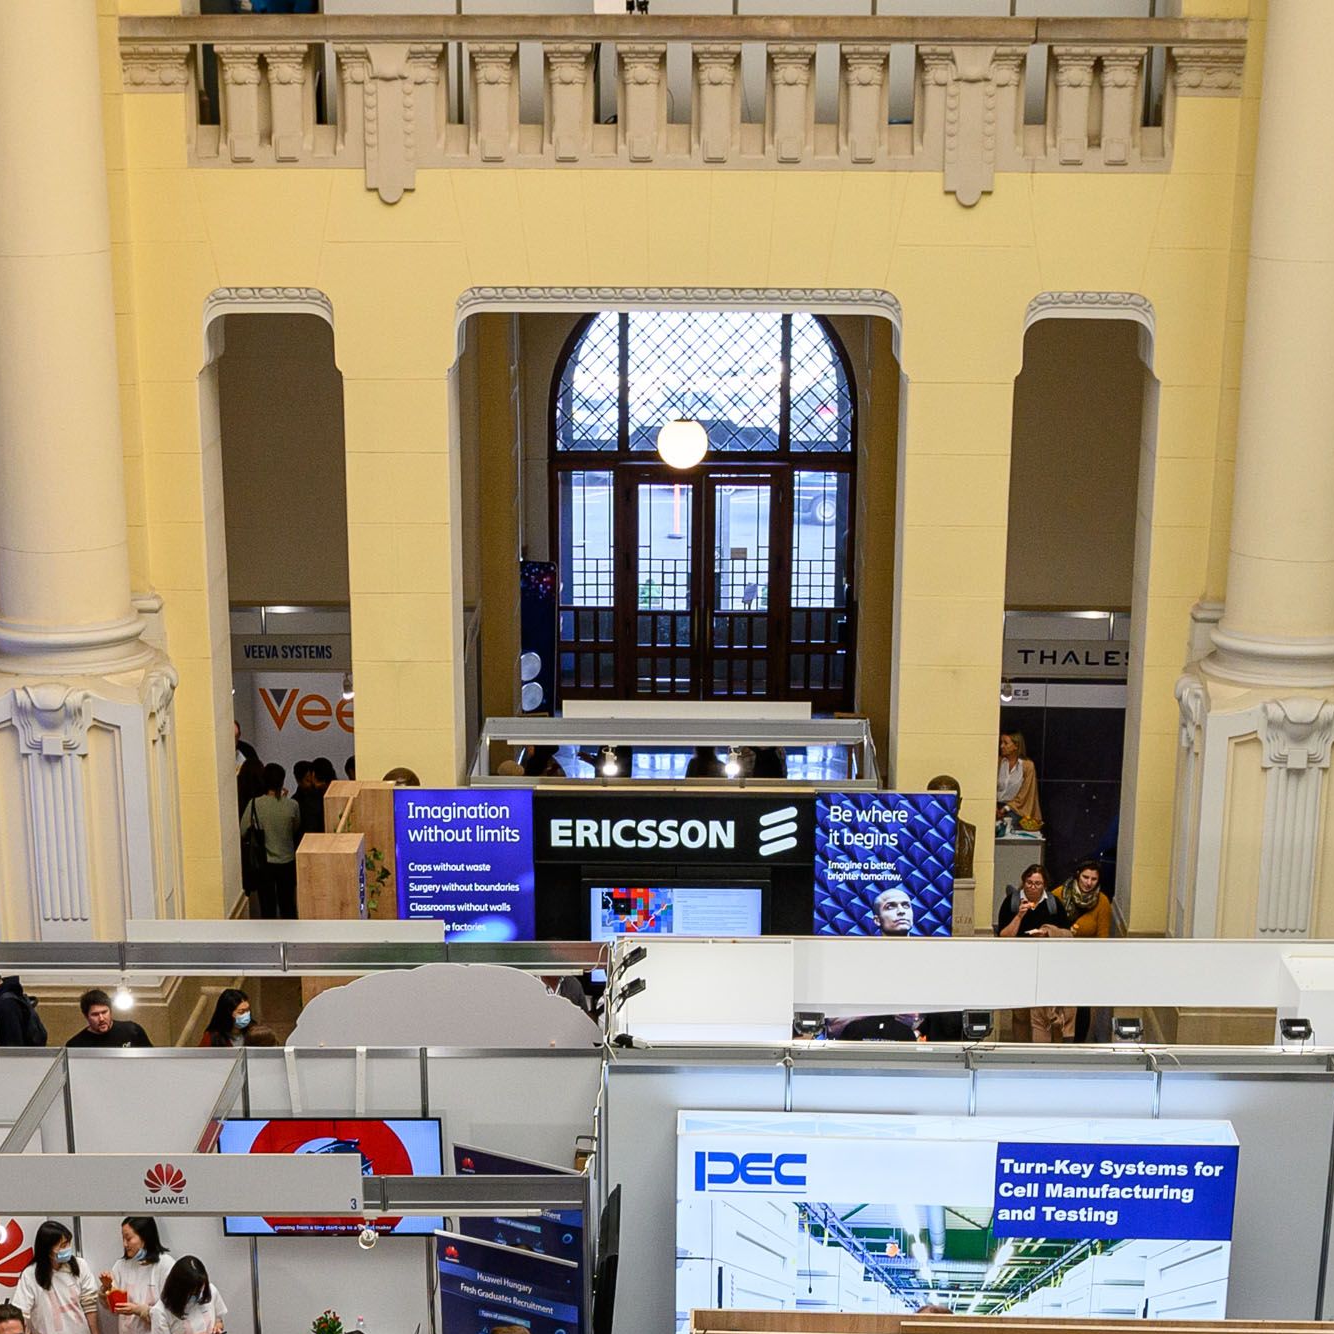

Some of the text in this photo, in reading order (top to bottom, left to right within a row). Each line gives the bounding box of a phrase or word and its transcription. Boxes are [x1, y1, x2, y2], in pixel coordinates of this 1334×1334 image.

[244, 645, 333, 659] VEEVA SYSTEMS
[1017, 649, 1129, 666] THALE
[407, 802, 509, 822] Imagination
[829, 805, 908, 823] Be where
[407, 825, 520, 842] without limits
[550, 819, 735, 849] ERICSSON
[828, 829, 899, 849] it begins
[408, 862, 492, 873] Crops without waste
[827, 861, 862, 871] Imagine
[870, 861, 897, 871] better,
[827, 872, 860, 882] brighter
[409, 882, 520, 893] Surgery without boundaries
[410, 902, 512, 912] Classrooms without walls
[1000, 1158, 1225, 1179] Turn-Key Systems for
[145, 1196, 189, 1206] HUAWEI
[998, 1182, 1195, 1203] Cell Manufacturing
[350, 1199, 358, 1210] 3
[997, 1206, 1119, 1226] and Testing
[476, 1272, 533, 1295] Huawei Hungary
[460, 1282, 554, 1315] Fresh Graduates Recruitment
